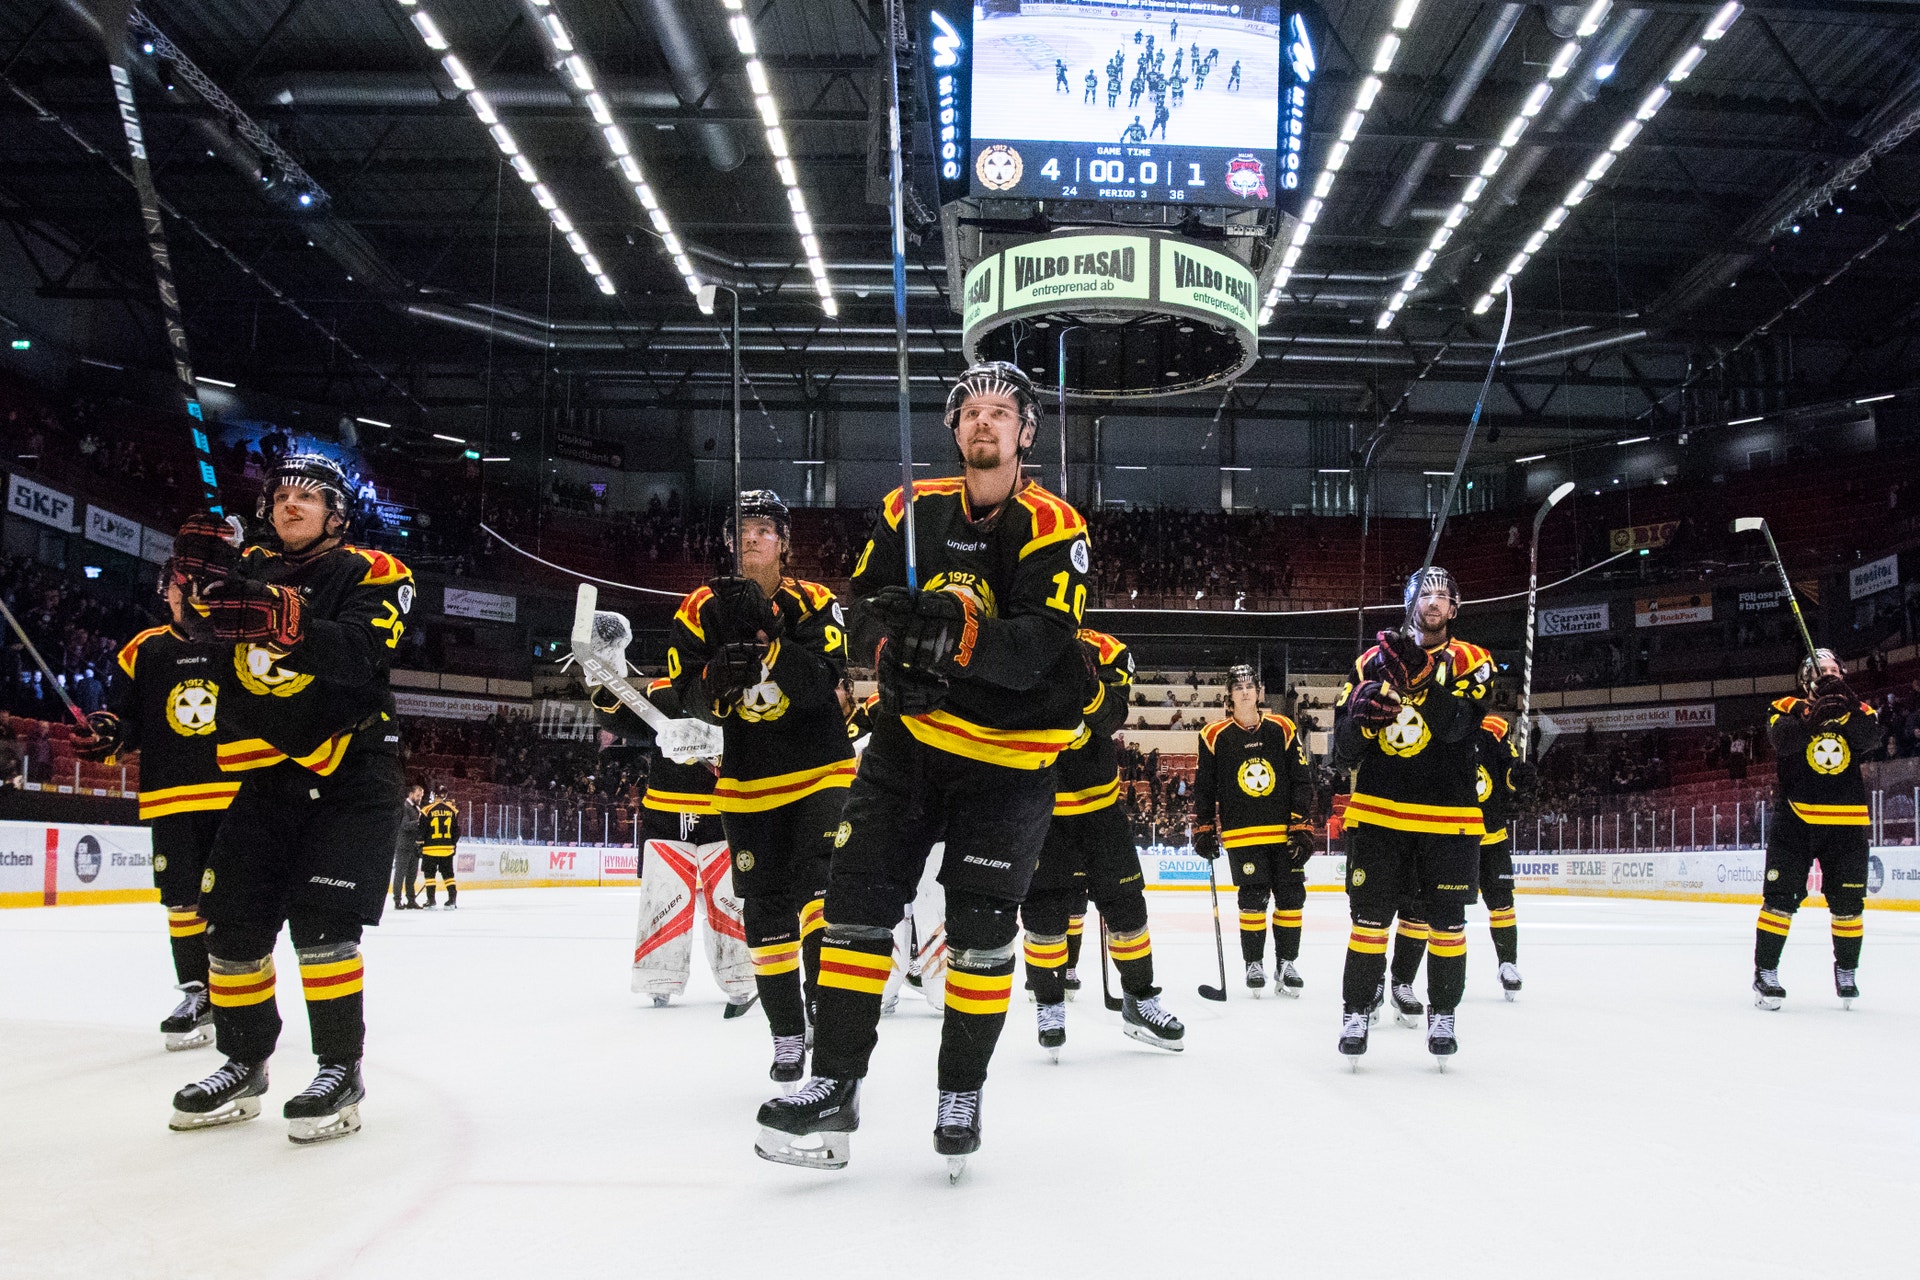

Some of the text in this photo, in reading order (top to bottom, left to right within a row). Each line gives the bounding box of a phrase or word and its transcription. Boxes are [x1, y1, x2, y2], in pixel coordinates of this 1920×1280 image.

[109, 64, 147, 160] BAUER
[1097, 147, 1151, 156] GAME TIME
[1040, 158, 1061, 180] 4
[1089, 160, 1158, 184] 00.0
[1188, 163, 1205, 186] 1
[1062, 186, 1078, 196] 24
[1100, 189, 1148, 198] PERIOD 3
[1169, 190, 1184, 200] 36
[1014, 246, 1136, 292] VALBO FASAD
[1174, 250, 1222, 290] VALBO
[1032, 278, 1114, 296] entreprenad ab
[1192, 291, 1239, 314] entreprenad
[15, 484, 68, 519] SKF
[946, 538, 977, 552] unicef
[948, 572, 976, 586] 1912
[1046, 570, 1087, 626] 10
[1738, 592, 1757, 602] Följ
[1758, 592, 1774, 600] oss
[1551, 612, 1601, 624] Caravan
[1560, 620, 1602, 632] Marine
[176, 656, 200, 664] unicef
[584, 659, 650, 713] BAUER
[497, 704, 530, 718] MAXI
[1572, 714, 1602, 725] veckans
[1606, 714, 1622, 722] mat
[1624, 712, 1634, 722] på
[1674, 708, 1712, 722] MAXI
[430, 817, 452, 839] 11
[111, 852, 126, 866] För
[128, 853, 146, 866] alla
[500, 852, 529, 876] Cheers
[550, 852, 577, 870] MFT
[963, 854, 1012, 870] BAUER
[1572, 861, 1602, 876] PEAB
[1727, 866, 1764, 882] nettbus
[1892, 869, 1906, 880] För
[309, 876, 356, 890] BAUER
[652, 894, 682, 926] BAUER
[956, 958, 992, 970] BAUER
